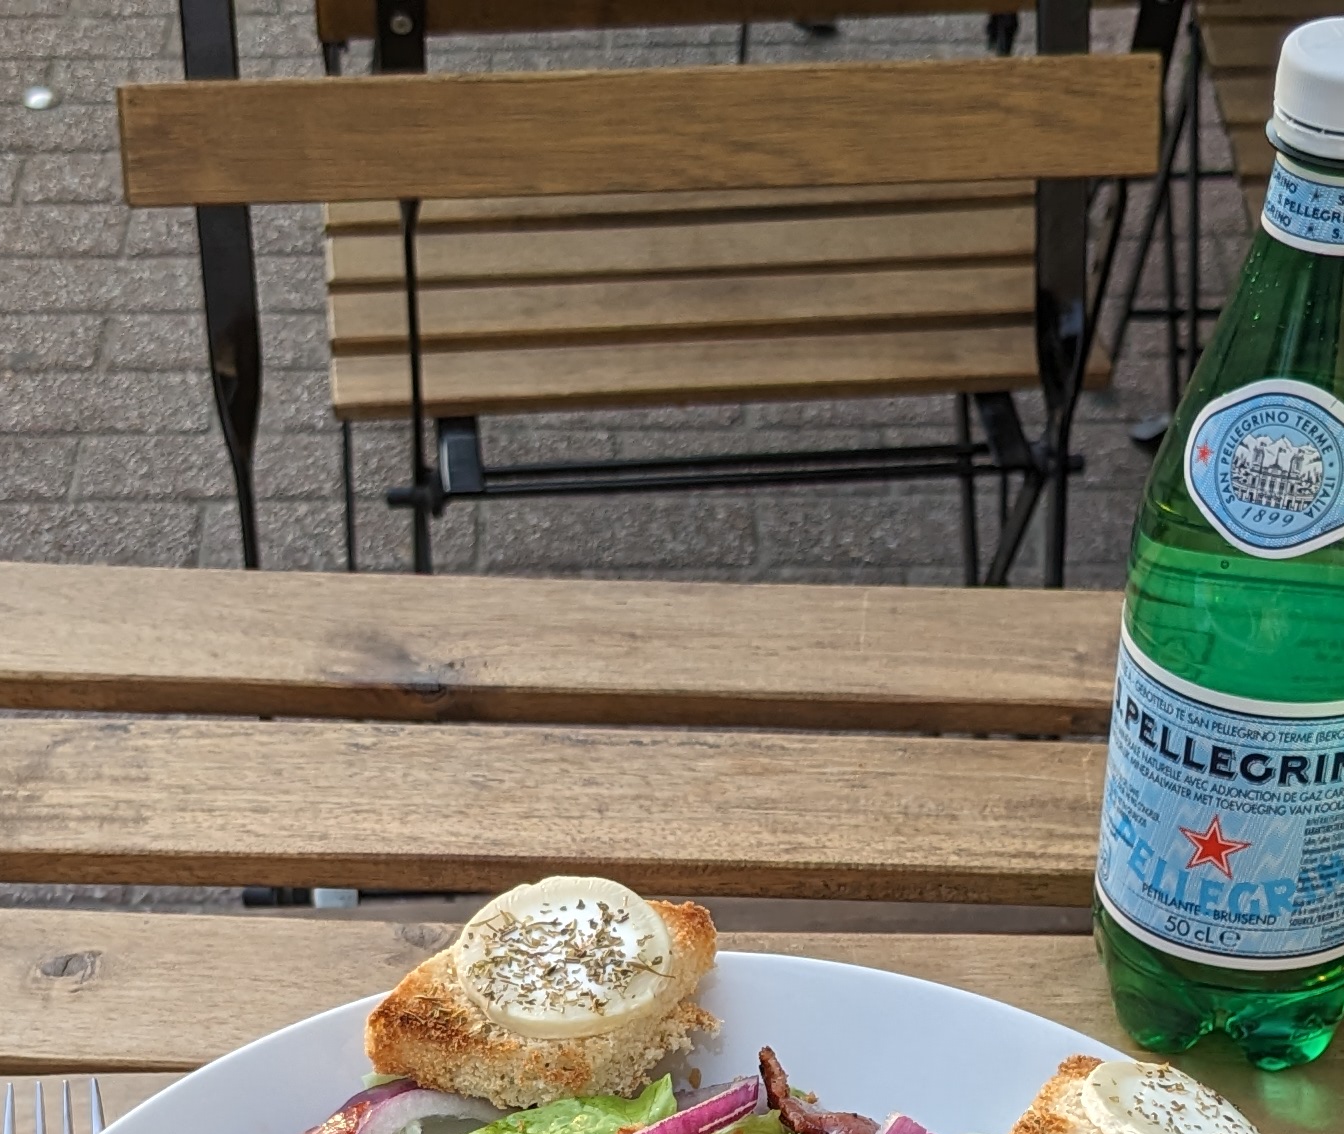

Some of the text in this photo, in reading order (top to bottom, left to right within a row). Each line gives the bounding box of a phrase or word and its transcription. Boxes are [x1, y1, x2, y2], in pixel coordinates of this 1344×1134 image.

[1220, 411, 1336, 519] SAN PELLEGRINO TERME ITALIA
[1241, 506, 1294, 527] 1899
[1176, 706, 1185, 721] TE
[1187, 714, 1209, 731] SAN
[1211, 721, 1275, 743] PELLEGRINO
[1279, 731, 1313, 744] TERME
[1184, 775, 1210, 792] AVEC
[1210, 784, 1281, 801] ADJONCTION
[1283, 791, 1298, 802] DE
[1300, 789, 1323, 802] GAZ
[1193, 791, 1213, 806] MET
[1214, 799, 1286, 816] TOEVOEGING
[1289, 803, 1312, 815] VAN
[1164, 915, 1190, 937] 50
[1213, 909, 1277, 926] BRUISEND
